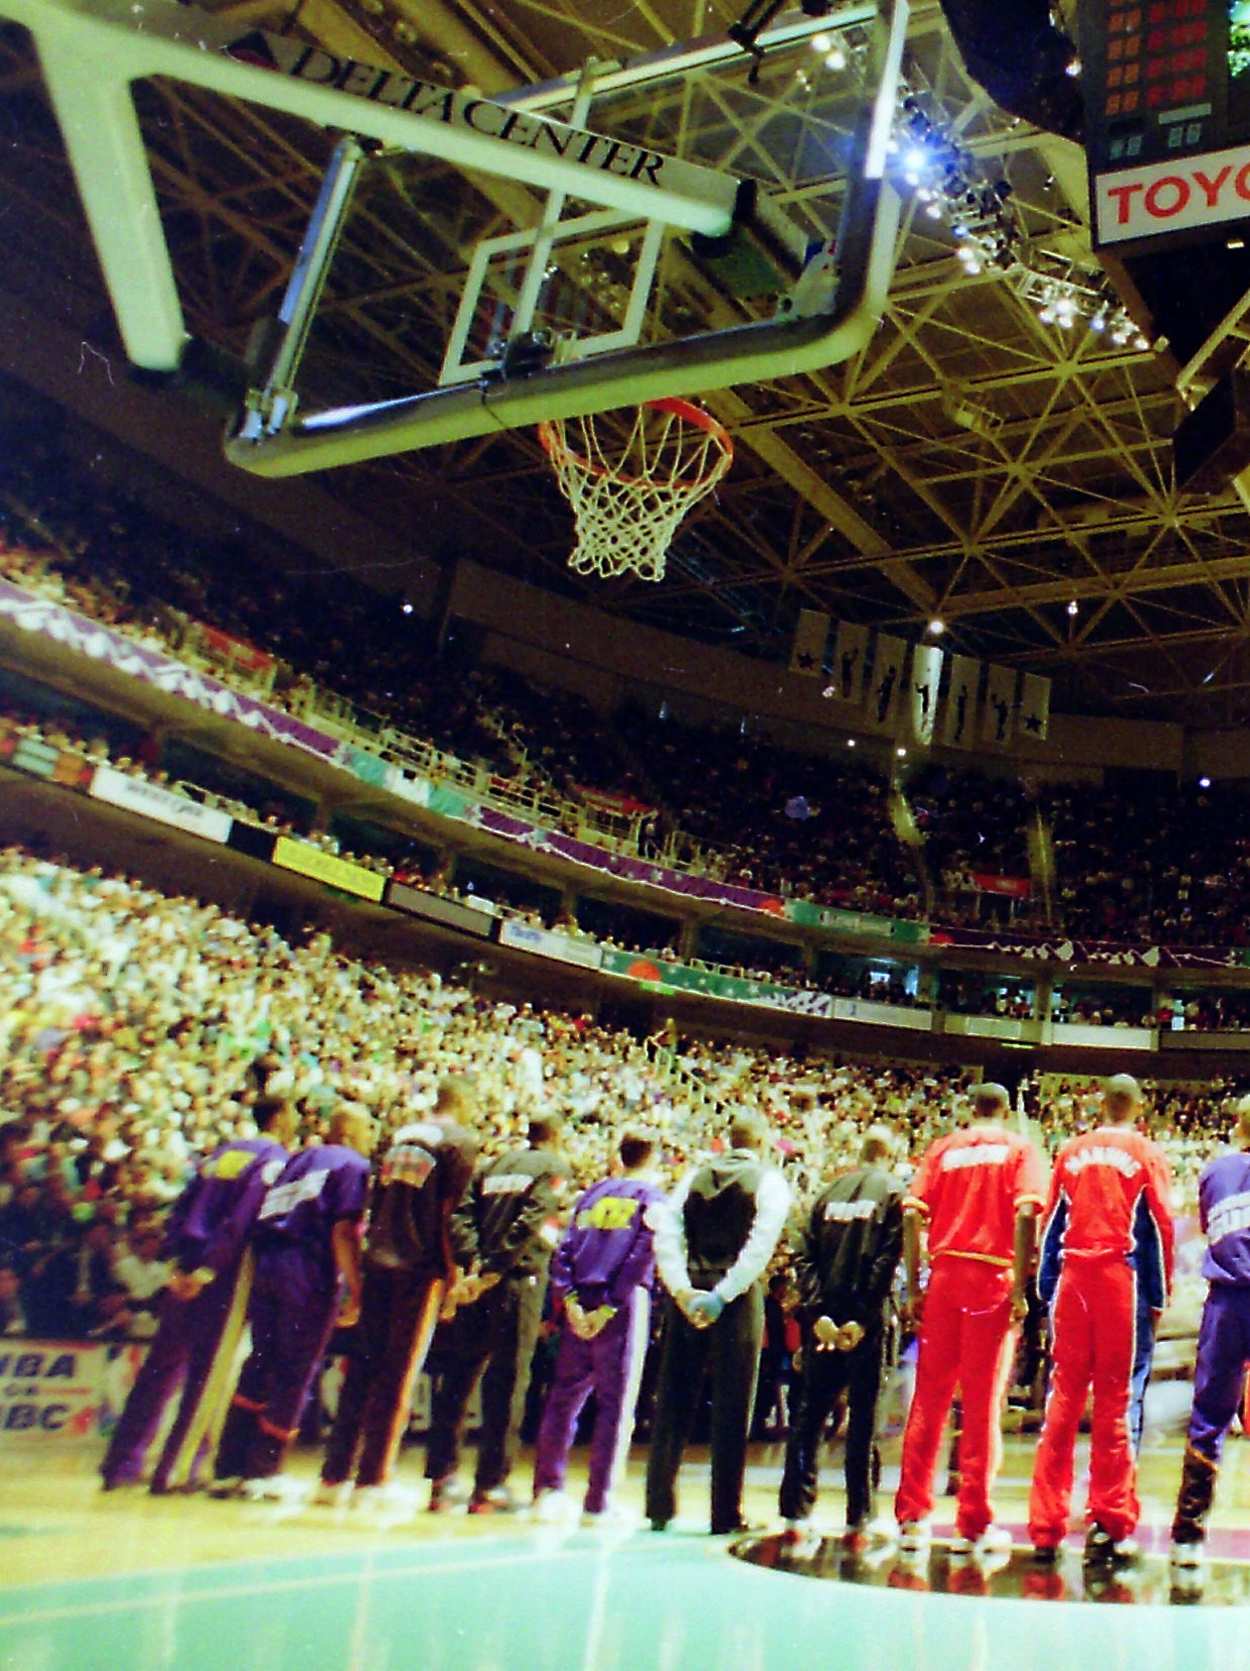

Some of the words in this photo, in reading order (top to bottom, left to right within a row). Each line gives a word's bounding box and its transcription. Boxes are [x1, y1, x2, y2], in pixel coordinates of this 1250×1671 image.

[289, 45, 456, 124] DELTA
[463, 100, 665, 187] CENTER
[0, 1403, 69, 1431] BC
